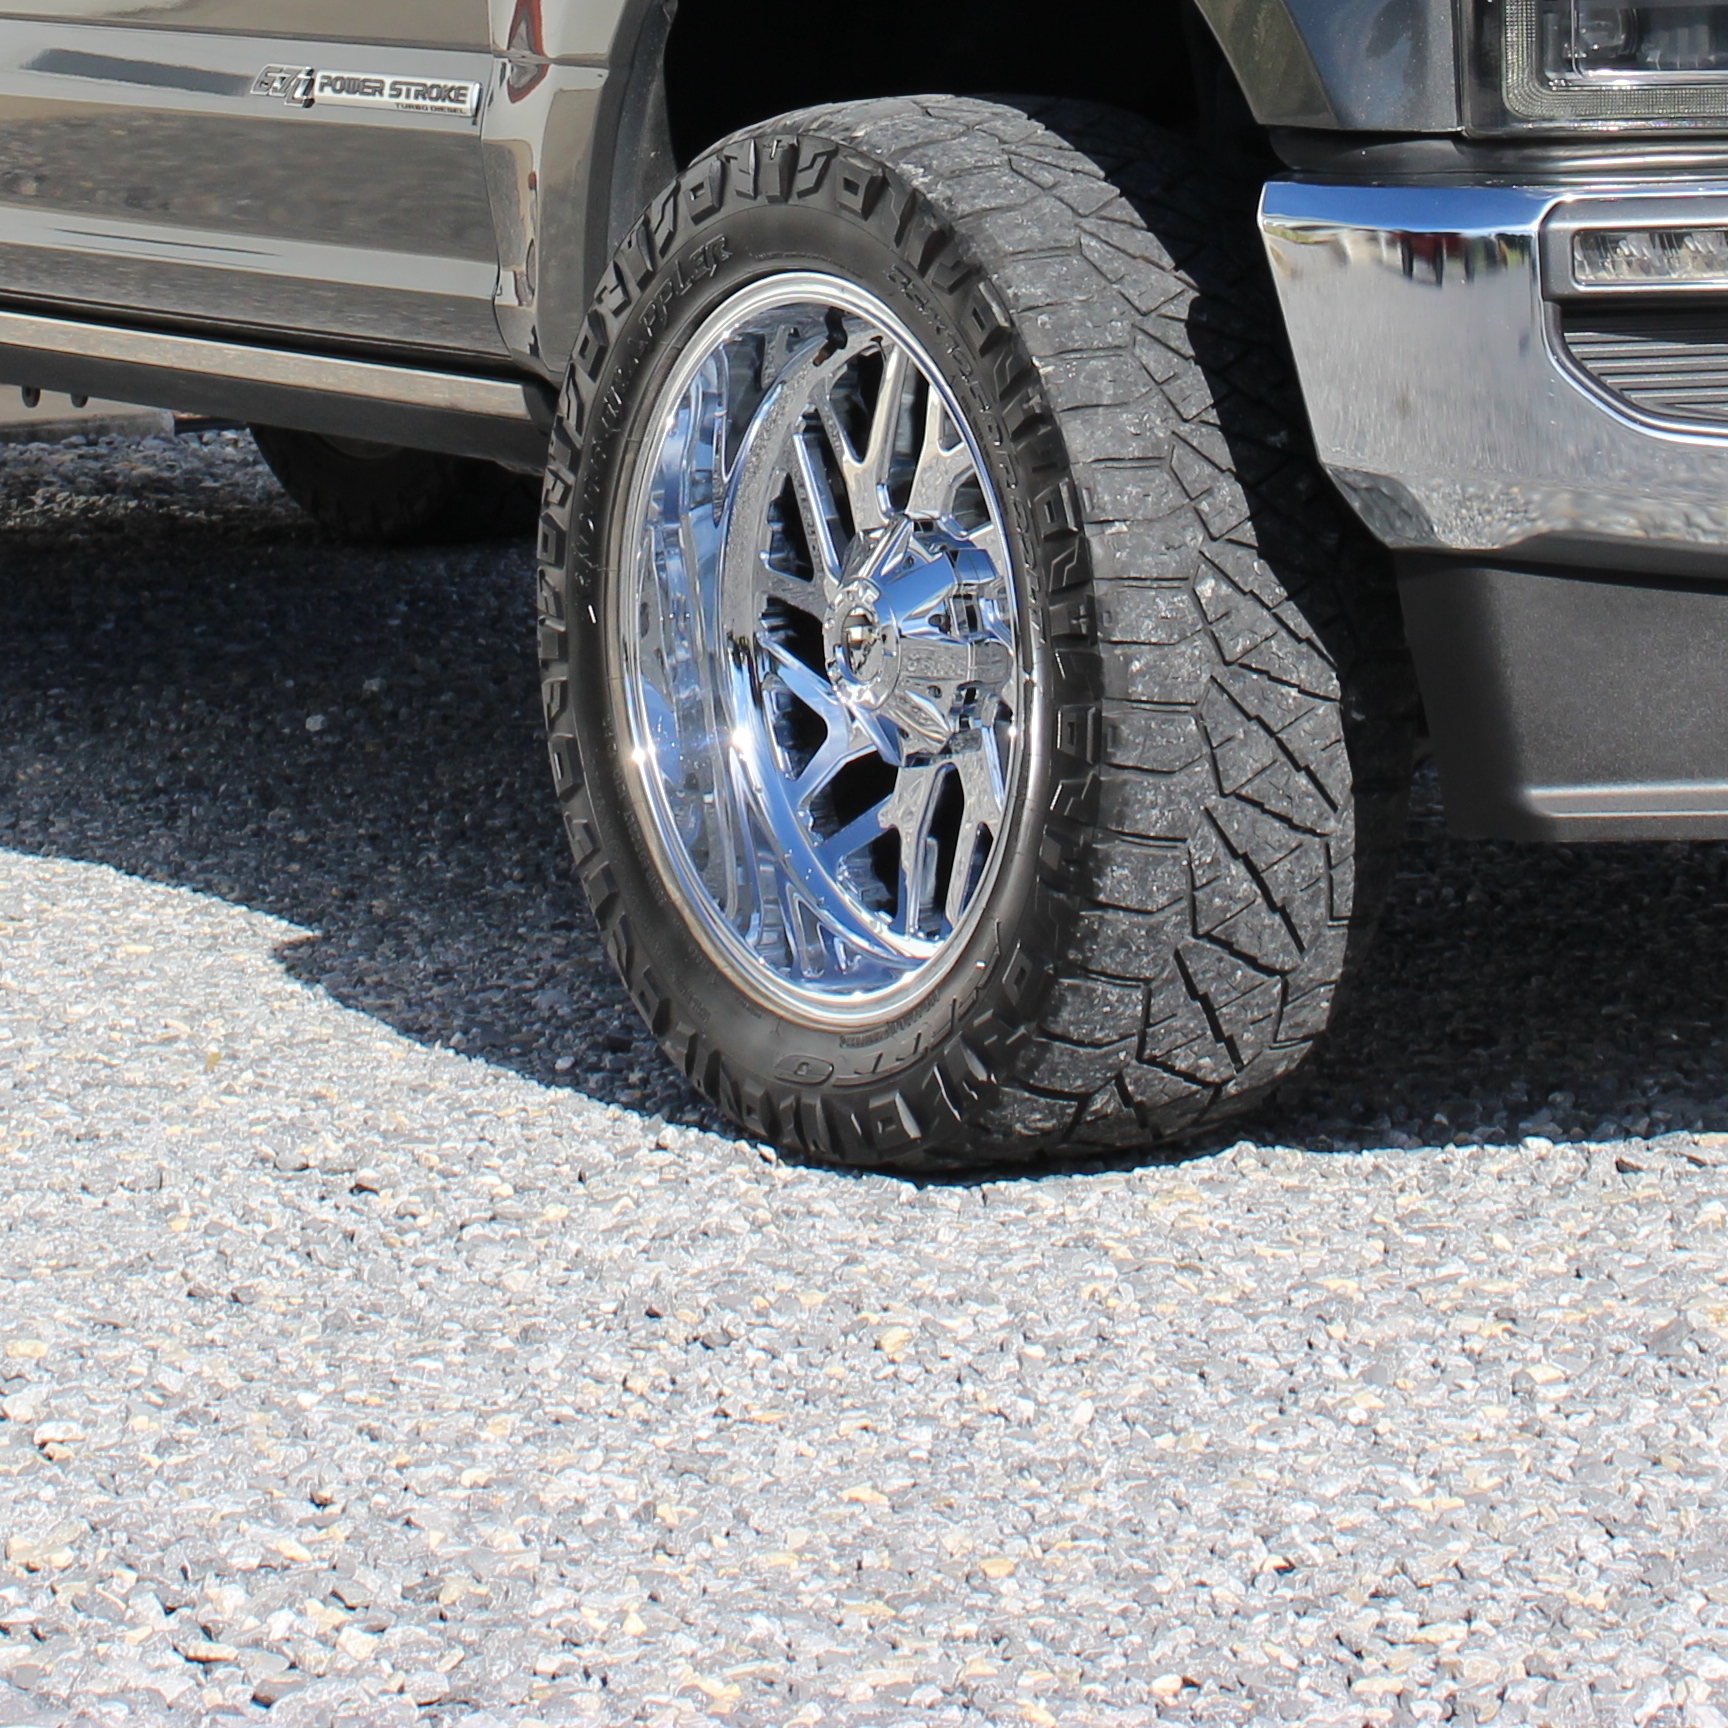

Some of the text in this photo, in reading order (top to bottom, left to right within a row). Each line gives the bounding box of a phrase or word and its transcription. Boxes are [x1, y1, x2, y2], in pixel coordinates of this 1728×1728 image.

[318, 74, 385, 97] POWER
[388, 79, 469, 104] STROKE
[394, 102, 467, 115] TURBO DIESEL
